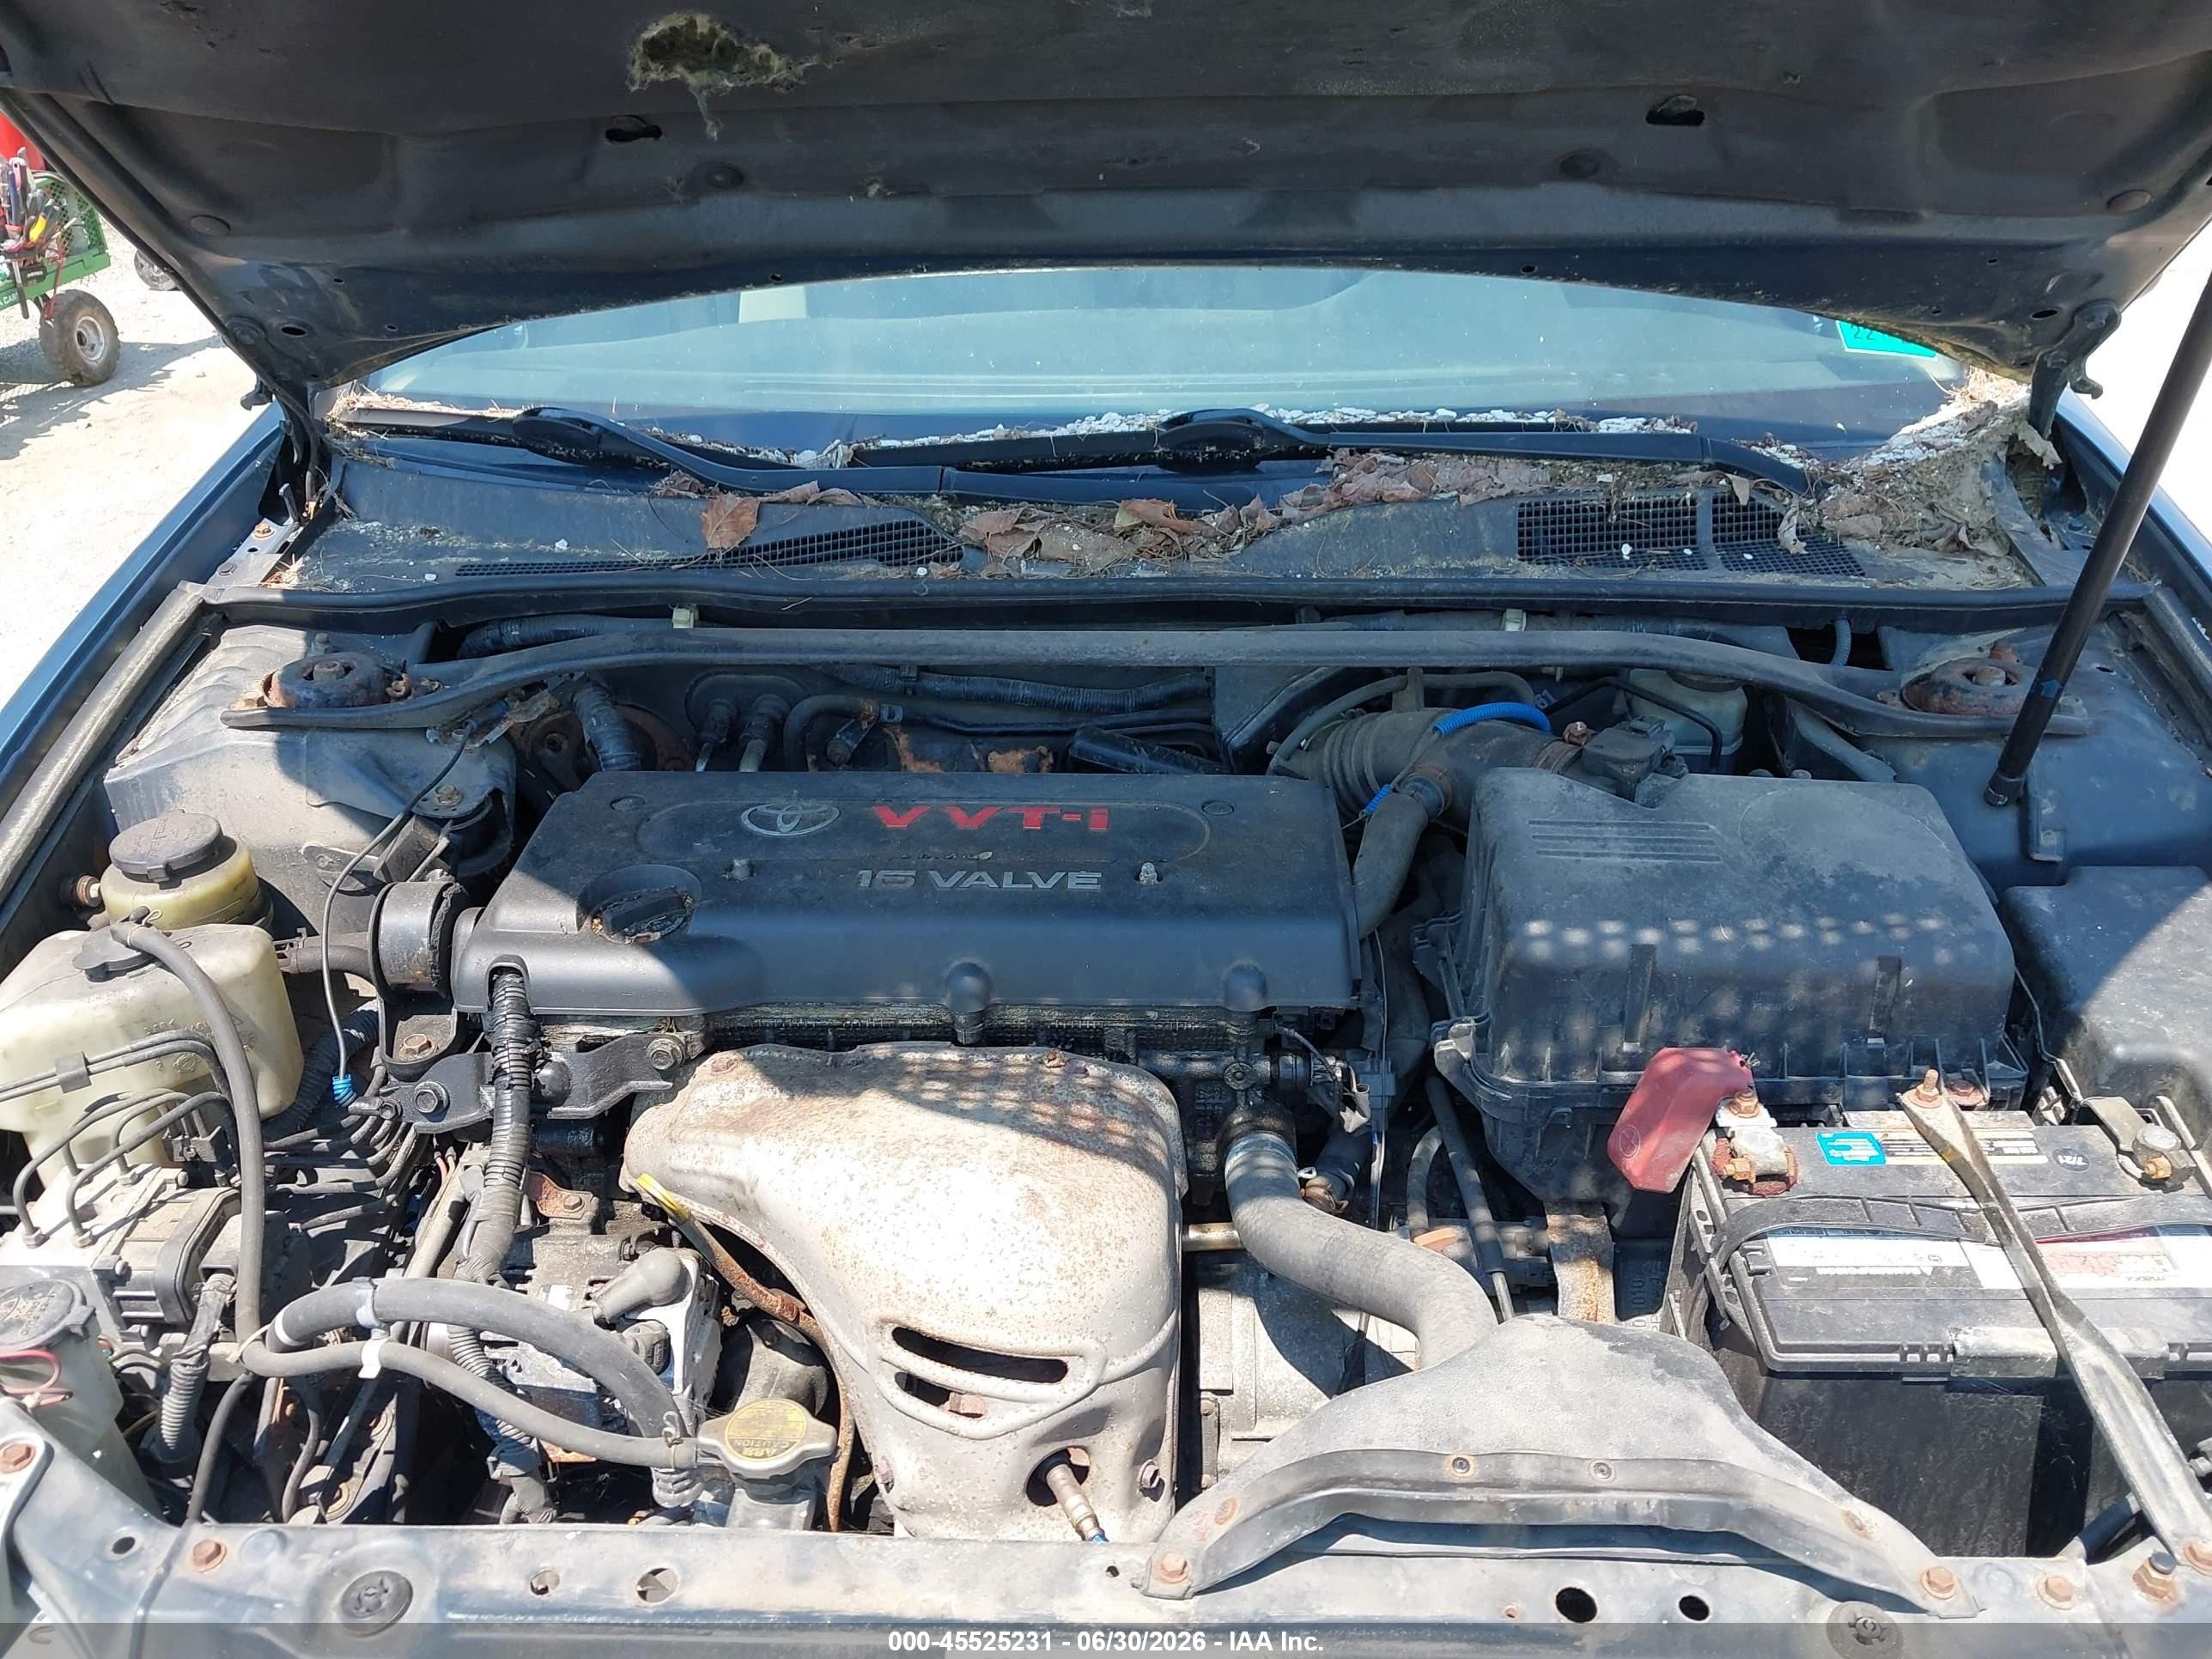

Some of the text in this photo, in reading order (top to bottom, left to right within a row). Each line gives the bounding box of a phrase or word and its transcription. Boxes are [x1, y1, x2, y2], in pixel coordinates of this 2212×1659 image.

[858, 870, 1103, 890] 16 VALVE
[733, 1439, 790, 1449] CAUTION
